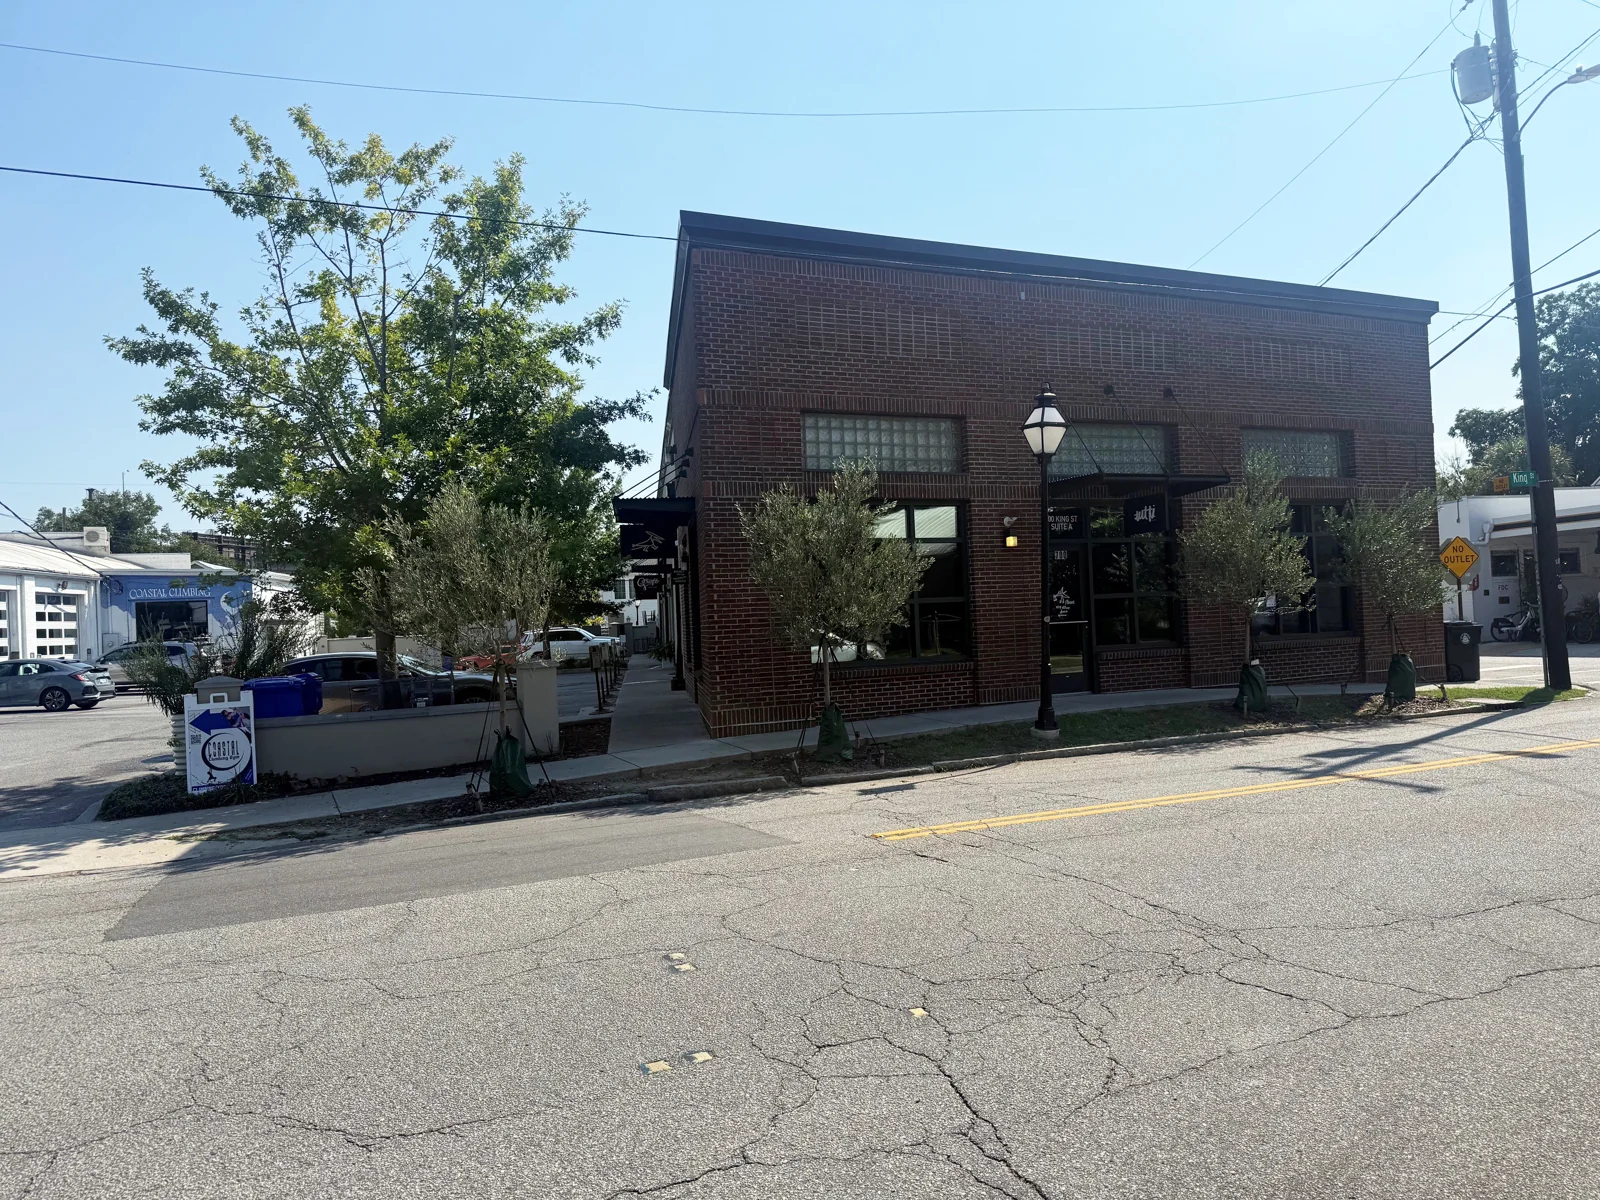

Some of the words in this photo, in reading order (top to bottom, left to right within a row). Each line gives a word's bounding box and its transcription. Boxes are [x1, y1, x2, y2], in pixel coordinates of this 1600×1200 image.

[1512, 472, 1528, 485] King
[1452, 545, 1464, 553] NO
[1443, 554, 1475, 563] OUTLET
[129, 588, 167, 599] COASTAL
[168, 587, 211, 597] CLIMBING
[207, 740, 239, 758] COASTAL
